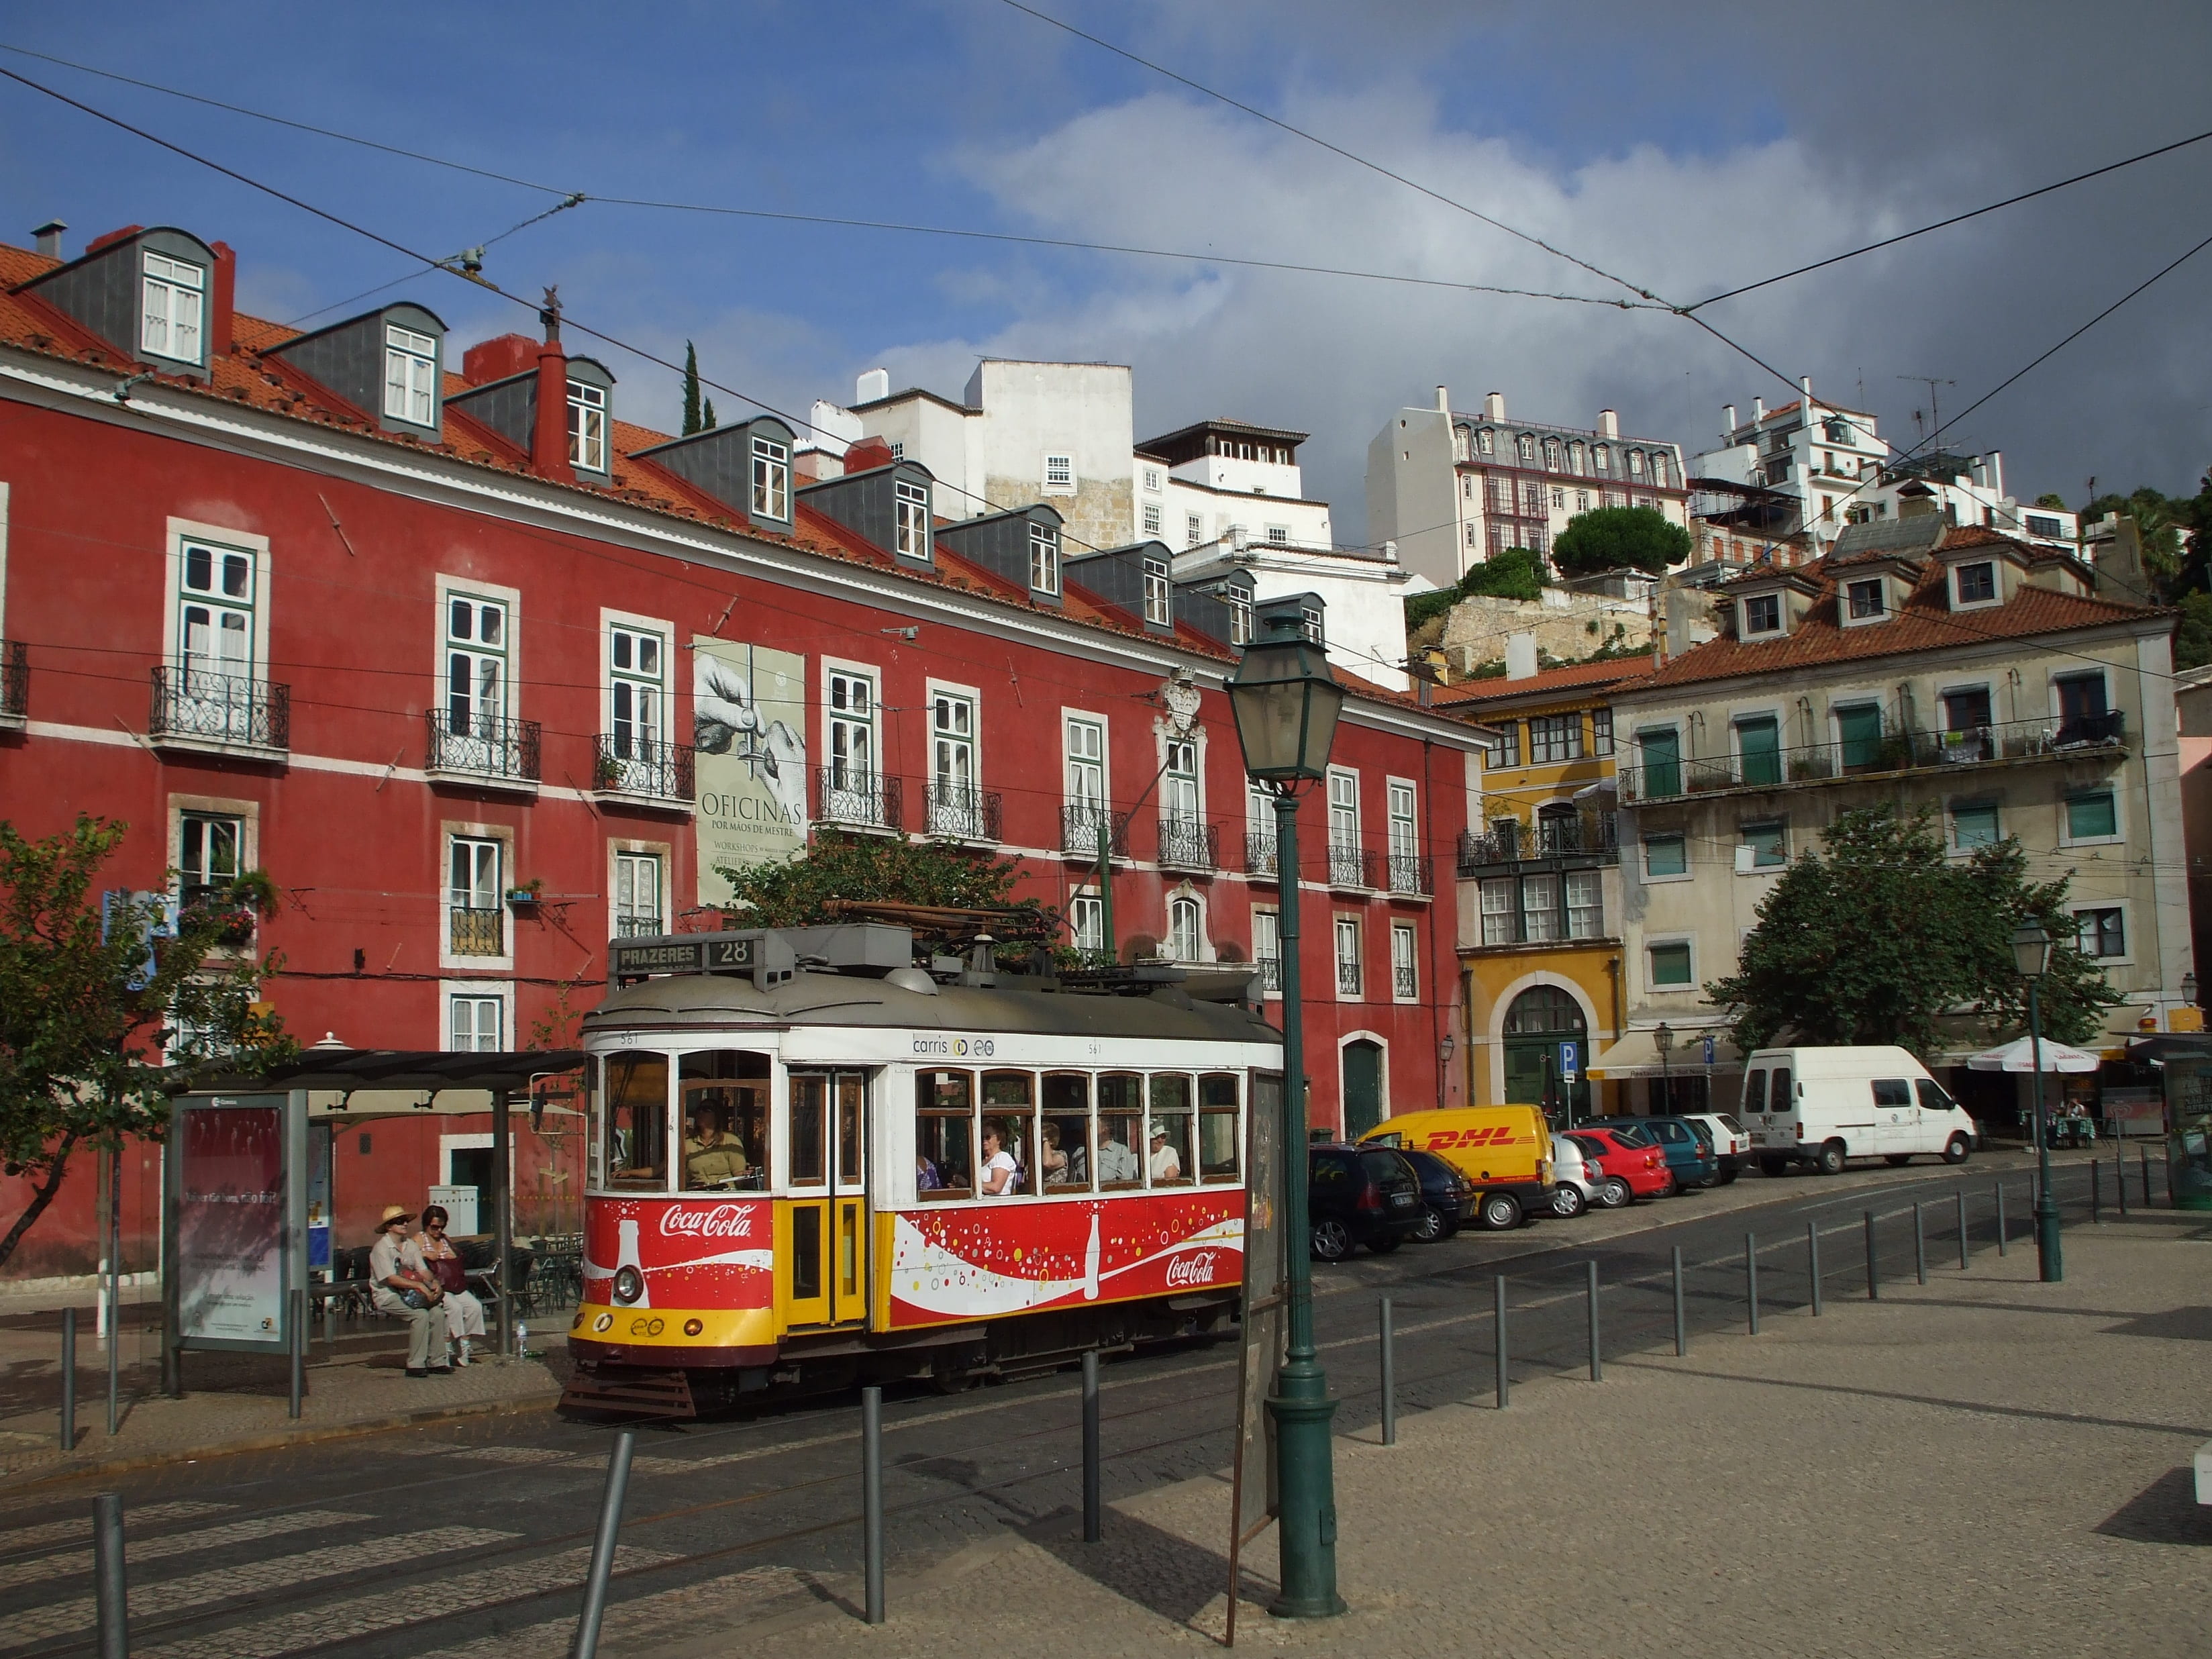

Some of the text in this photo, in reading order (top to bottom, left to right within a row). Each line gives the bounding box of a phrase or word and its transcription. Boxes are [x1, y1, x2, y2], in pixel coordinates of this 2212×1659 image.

[702, 793, 801, 825] OFICINAS
[712, 819, 793, 837] POR MÃOS DE MESTRE
[714, 840, 758, 853] WORKSHOPS
[621, 946, 695, 966] PRAZERES
[720, 941, 747, 962] 28
[621, 1031, 638, 1045] 561
[913, 1039, 948, 1053] carris
[1089, 1044, 1101, 1054] 561
[1563, 1046, 1574, 1071] P
[1427, 1127, 1515, 1151] DHL
[659, 1204, 757, 1237] Coca-Cola
[1166, 1252, 1216, 1287] Coca-Cola
